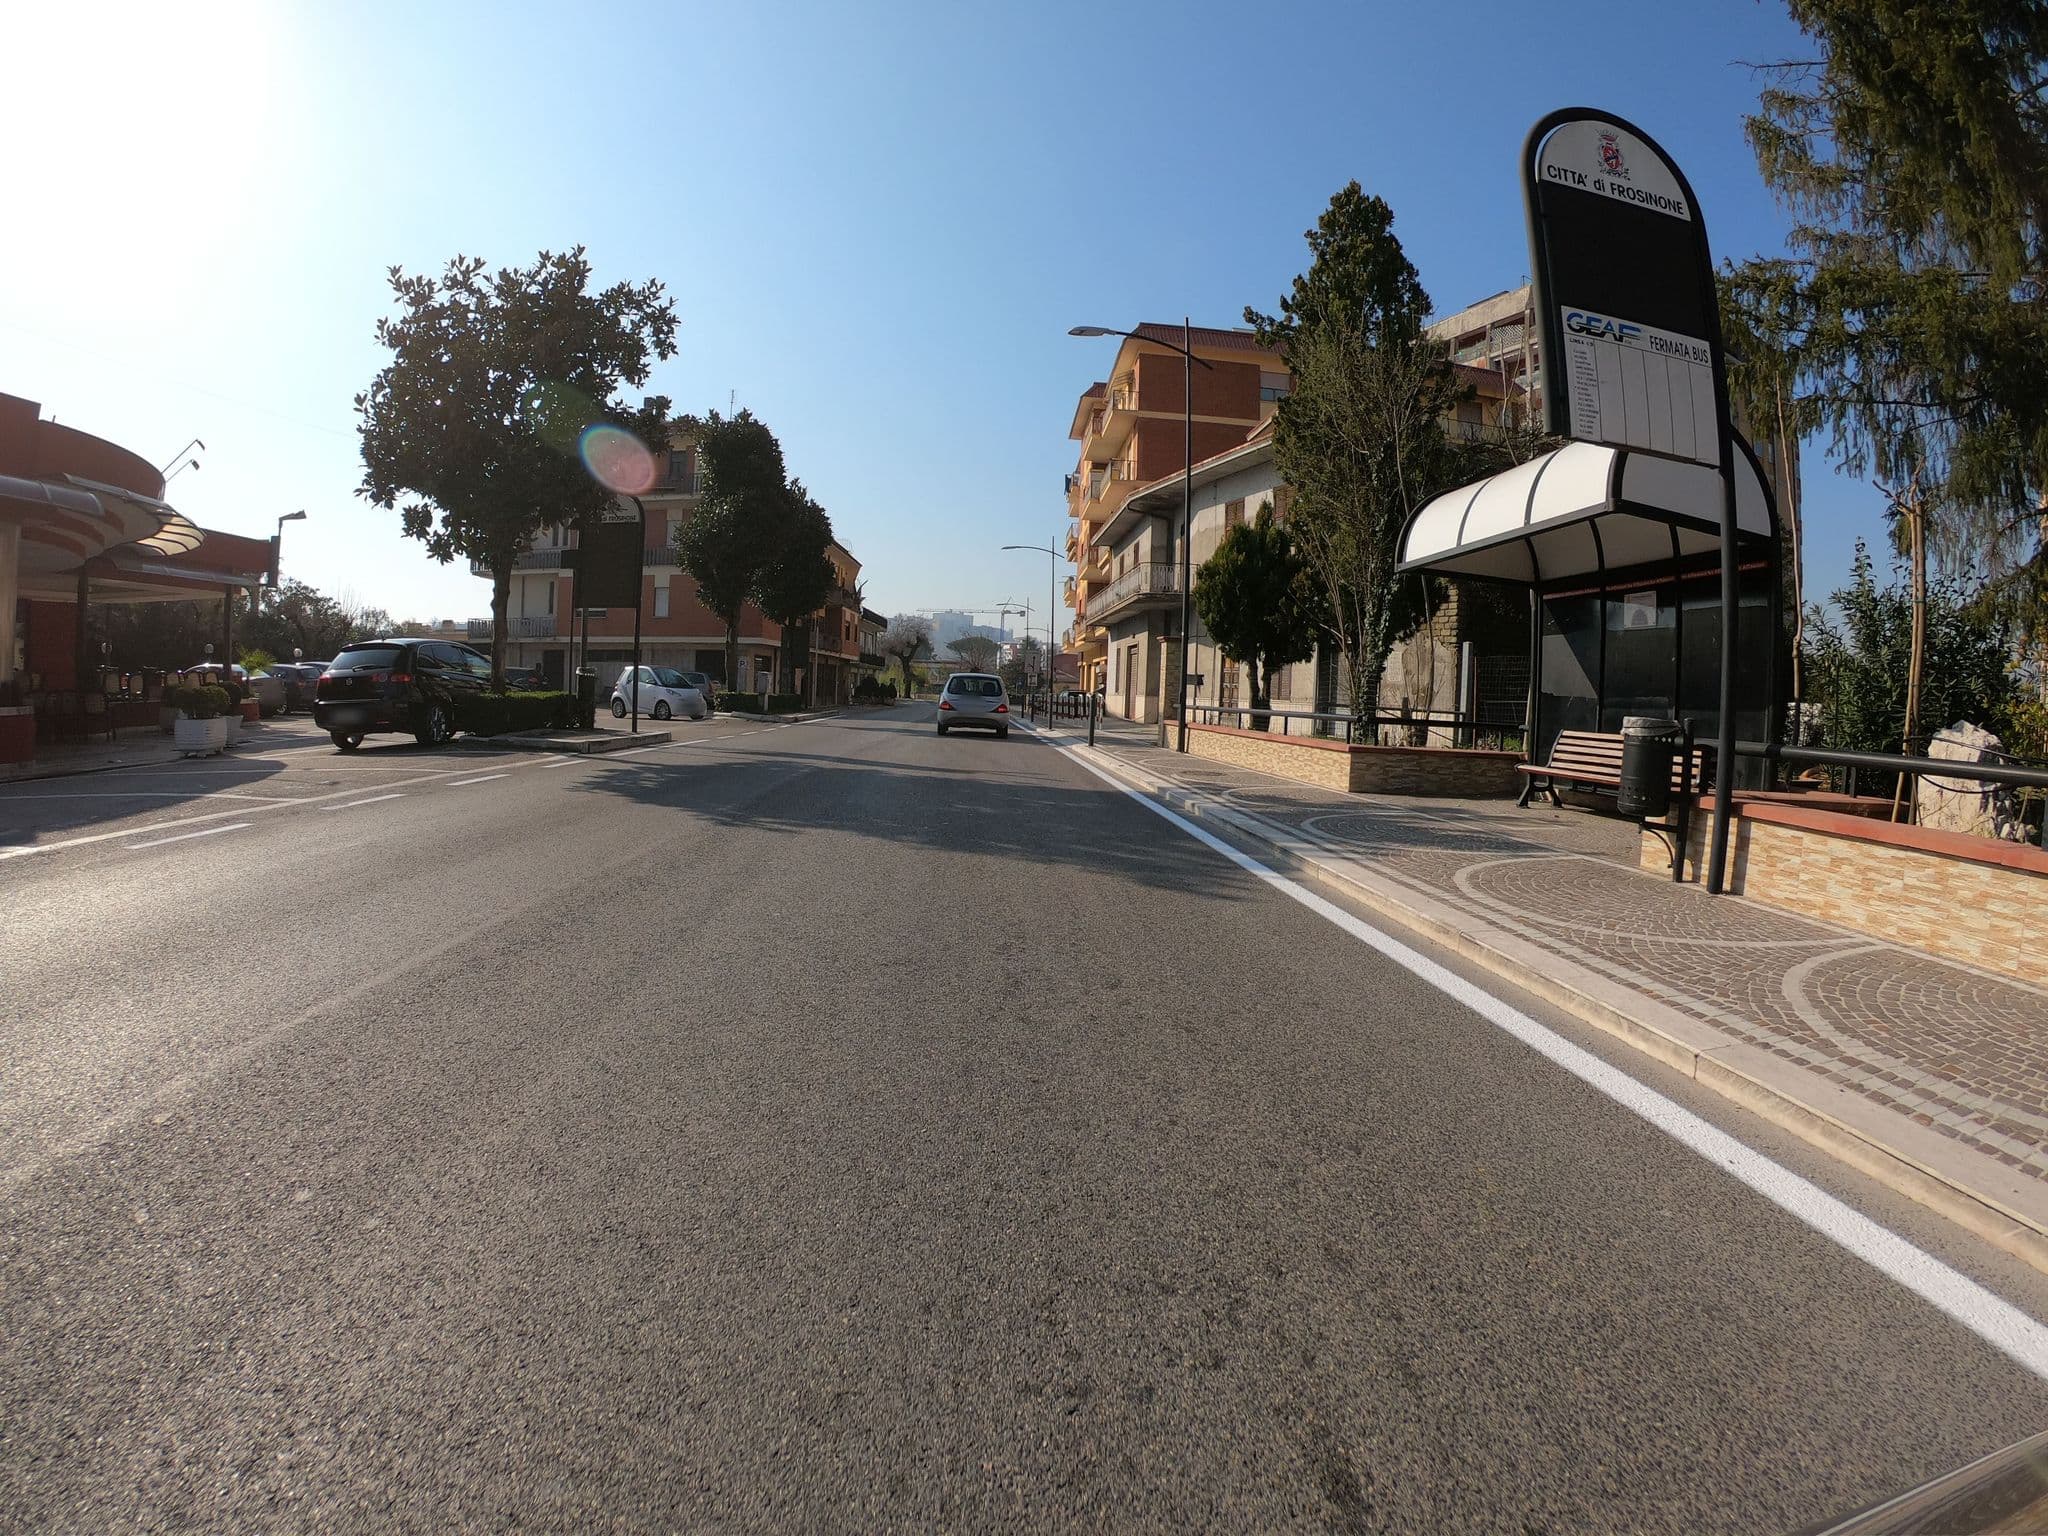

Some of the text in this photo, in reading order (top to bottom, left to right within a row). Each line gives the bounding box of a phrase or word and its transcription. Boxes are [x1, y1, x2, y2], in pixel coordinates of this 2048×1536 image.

[1594, 178, 1605, 192] di
[1610, 182, 1684, 215] FROSINONE
[1567, 312, 1641, 343] GEAF
[1649, 335, 1709, 363] FERMATA BUS
